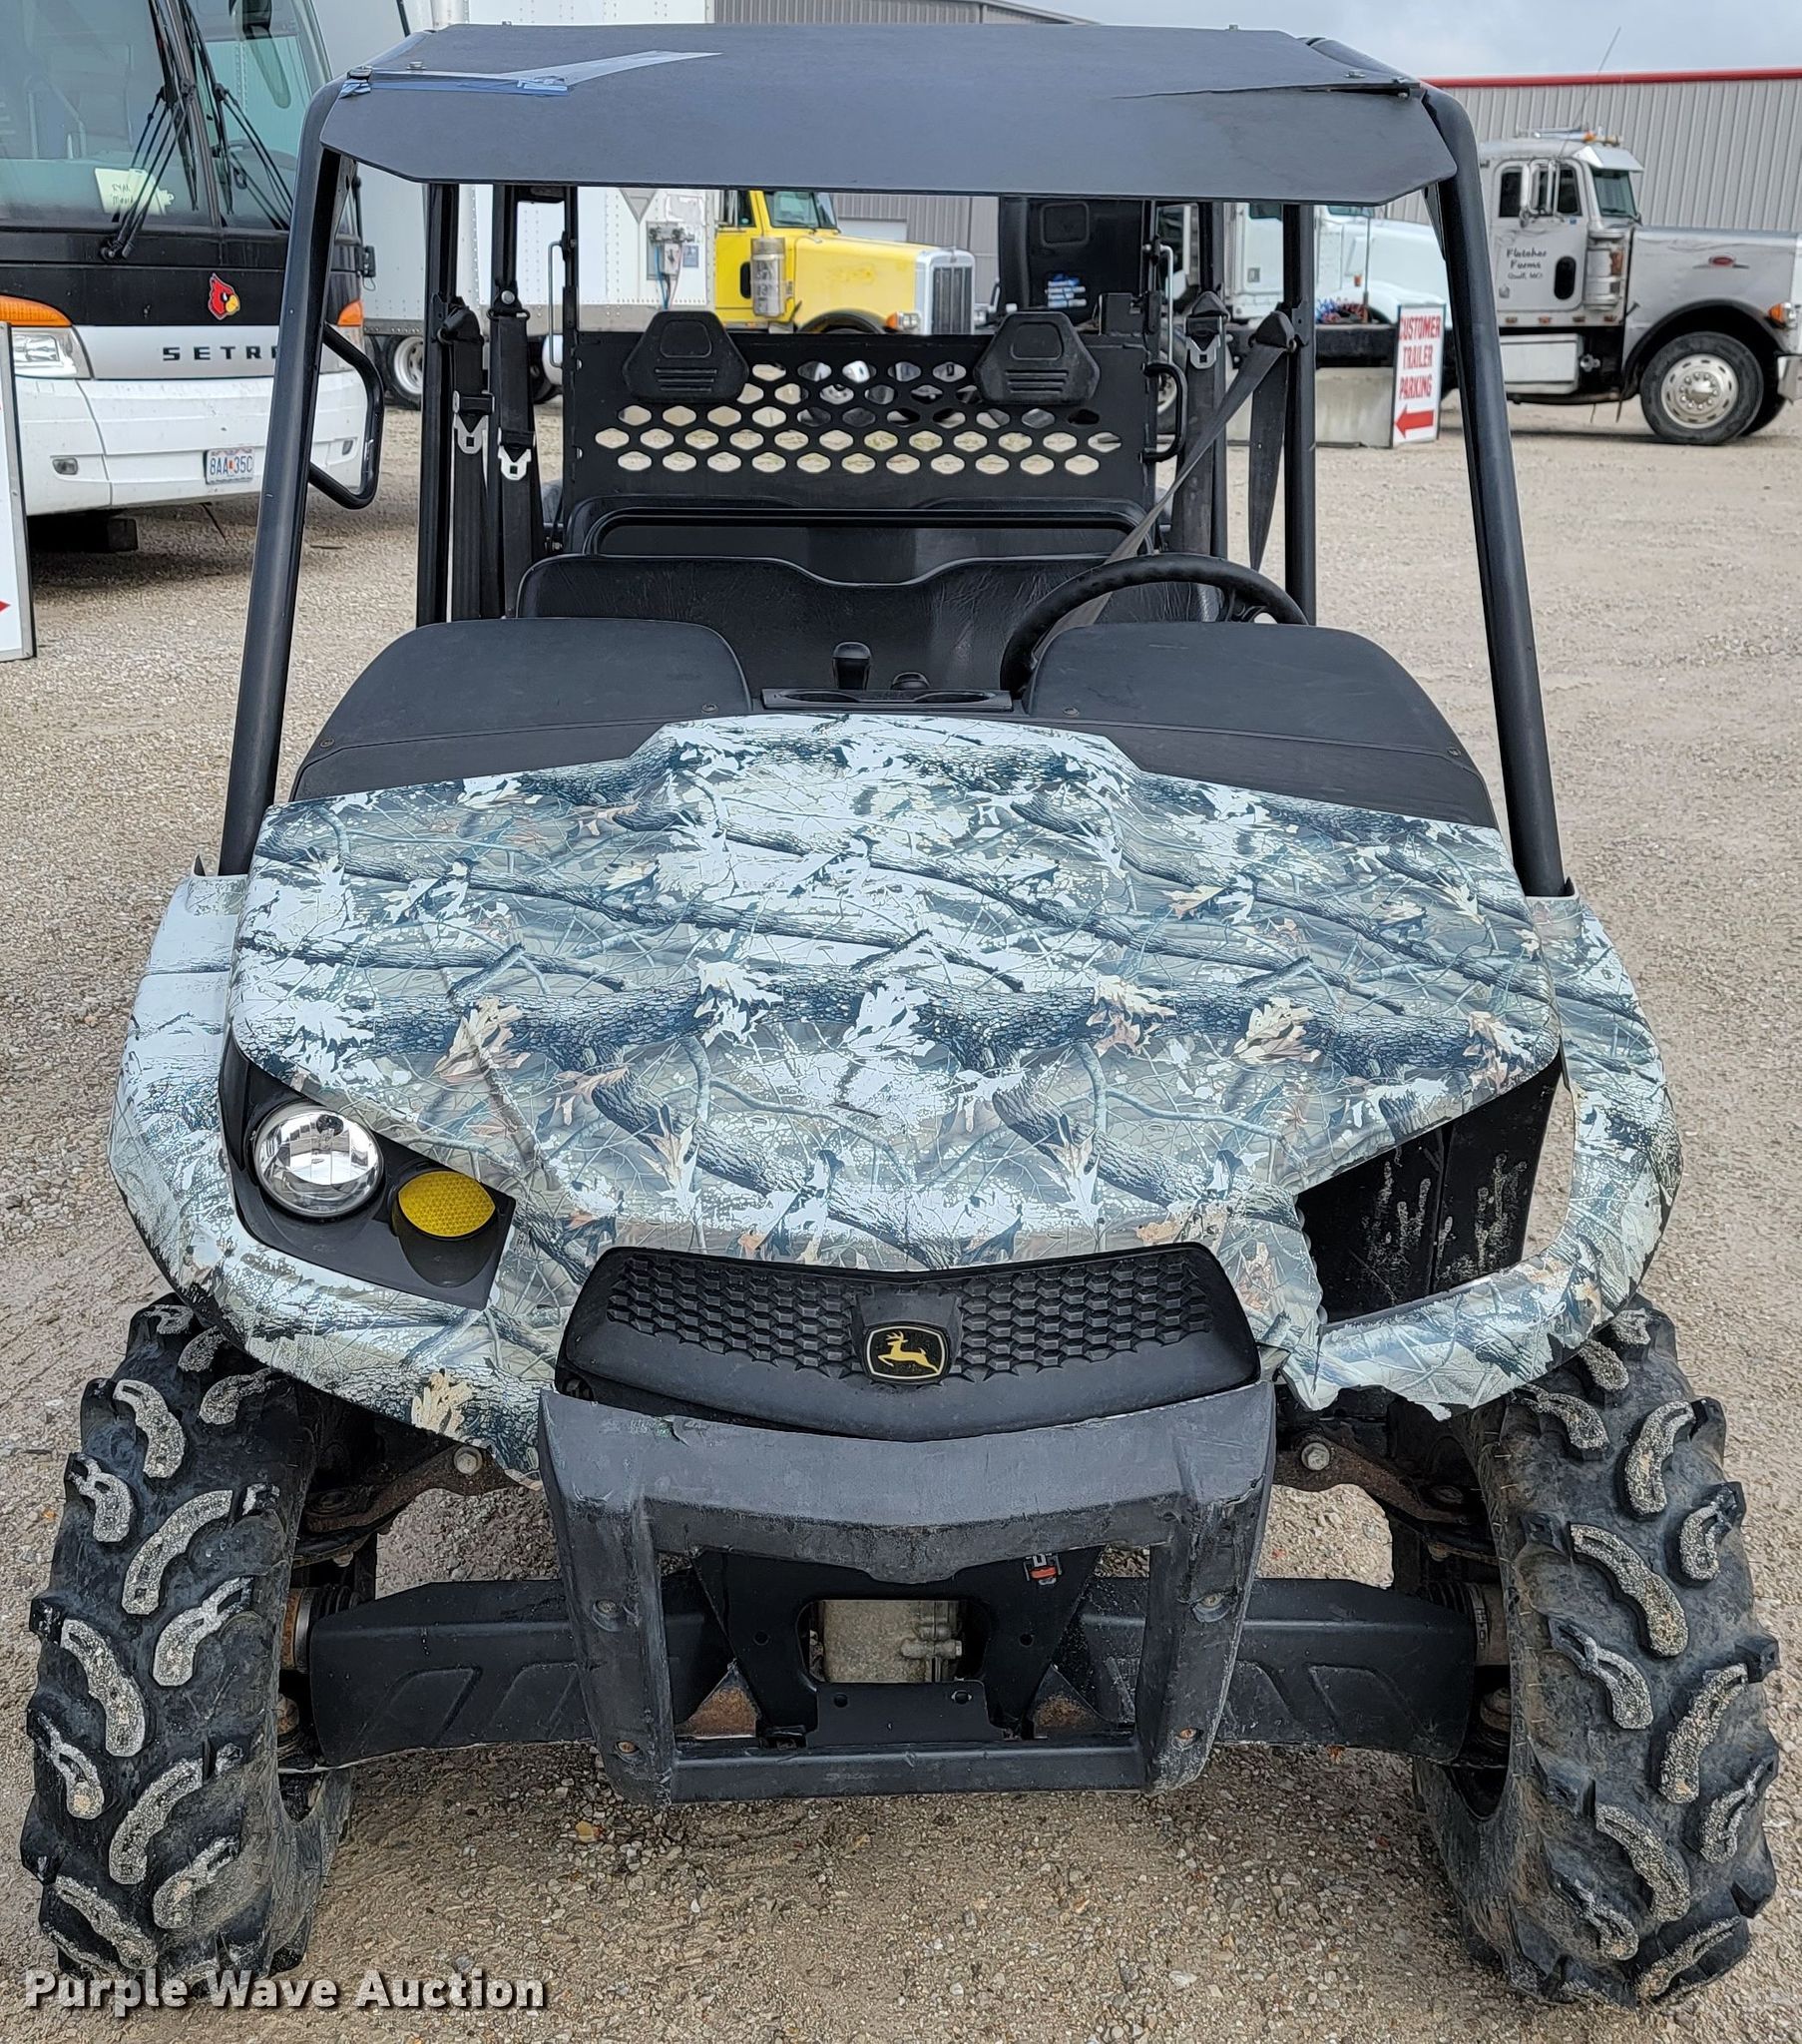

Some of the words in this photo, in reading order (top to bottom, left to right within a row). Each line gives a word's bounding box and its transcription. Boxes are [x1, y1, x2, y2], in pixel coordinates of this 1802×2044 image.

[1399, 315, 1441, 340] CUSTOMER
[1403, 344, 1433, 369] TRAILER
[1399, 373, 1432, 399] PARKING
